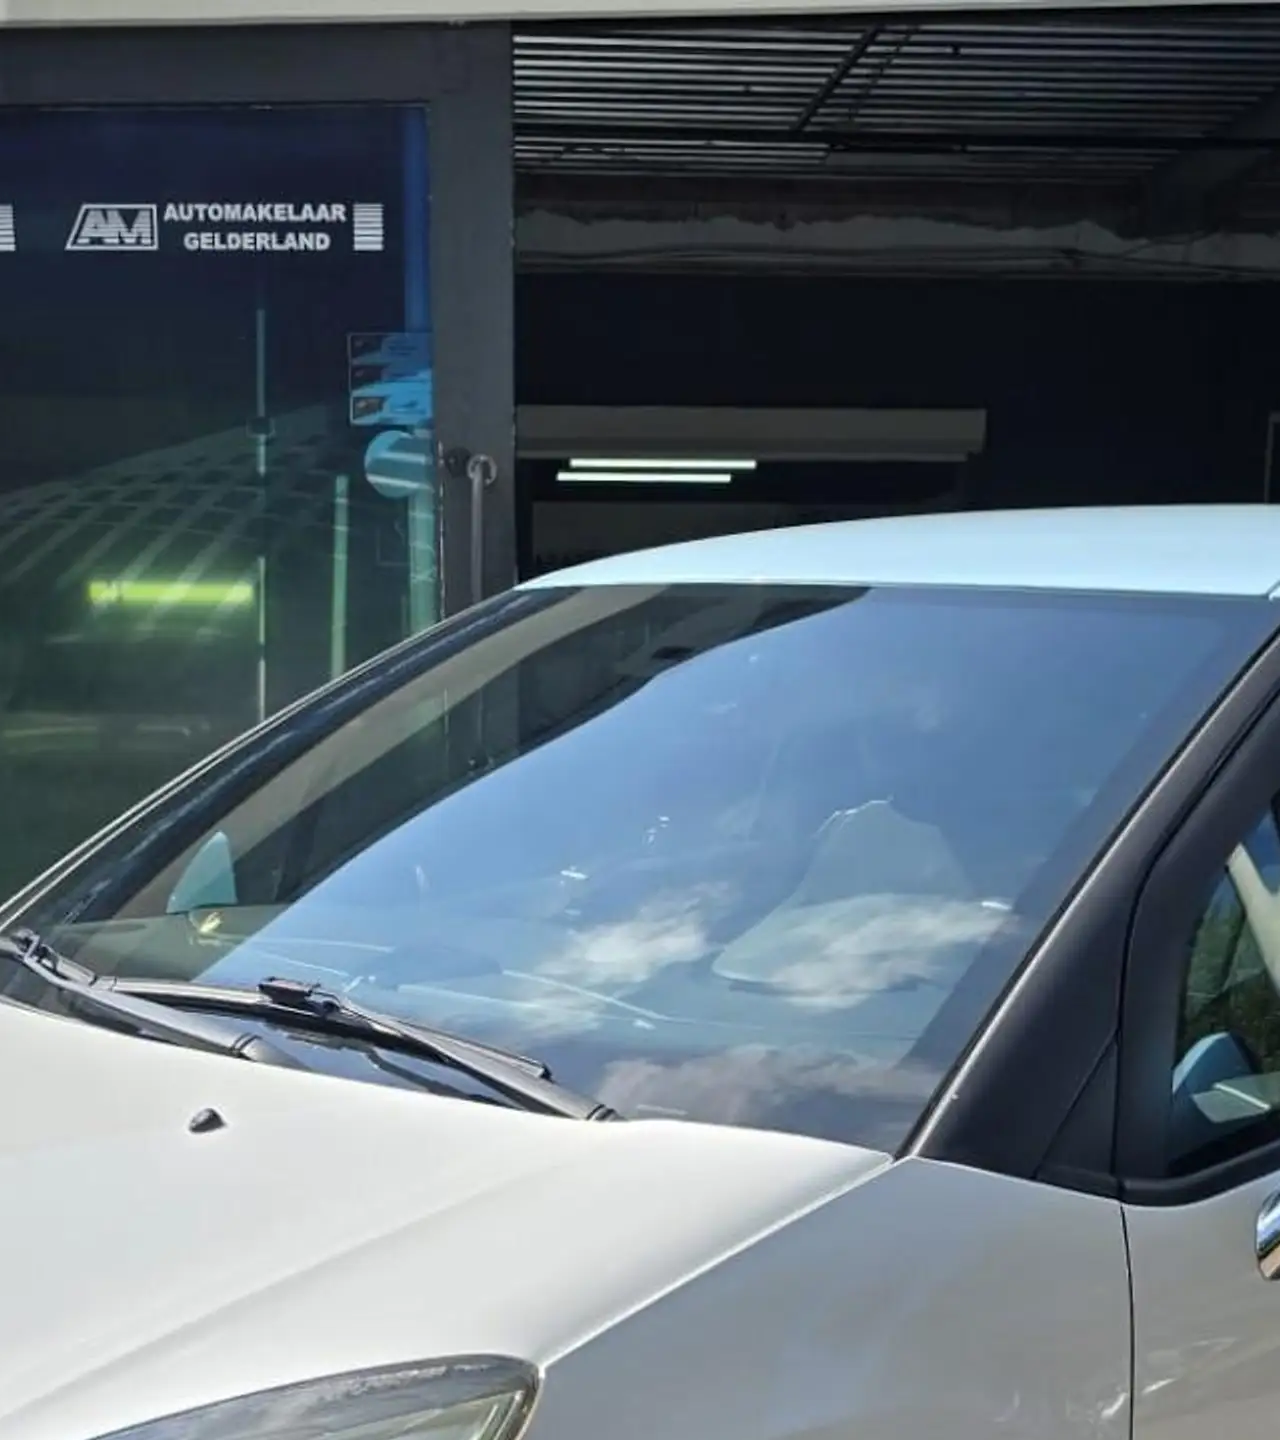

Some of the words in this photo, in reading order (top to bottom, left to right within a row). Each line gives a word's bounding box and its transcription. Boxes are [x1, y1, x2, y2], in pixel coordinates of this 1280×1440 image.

[163, 203, 347, 223] AUTOMAKELAAR
[76, 207, 152, 245] AM
[183, 231, 332, 251] GELDERLAND
